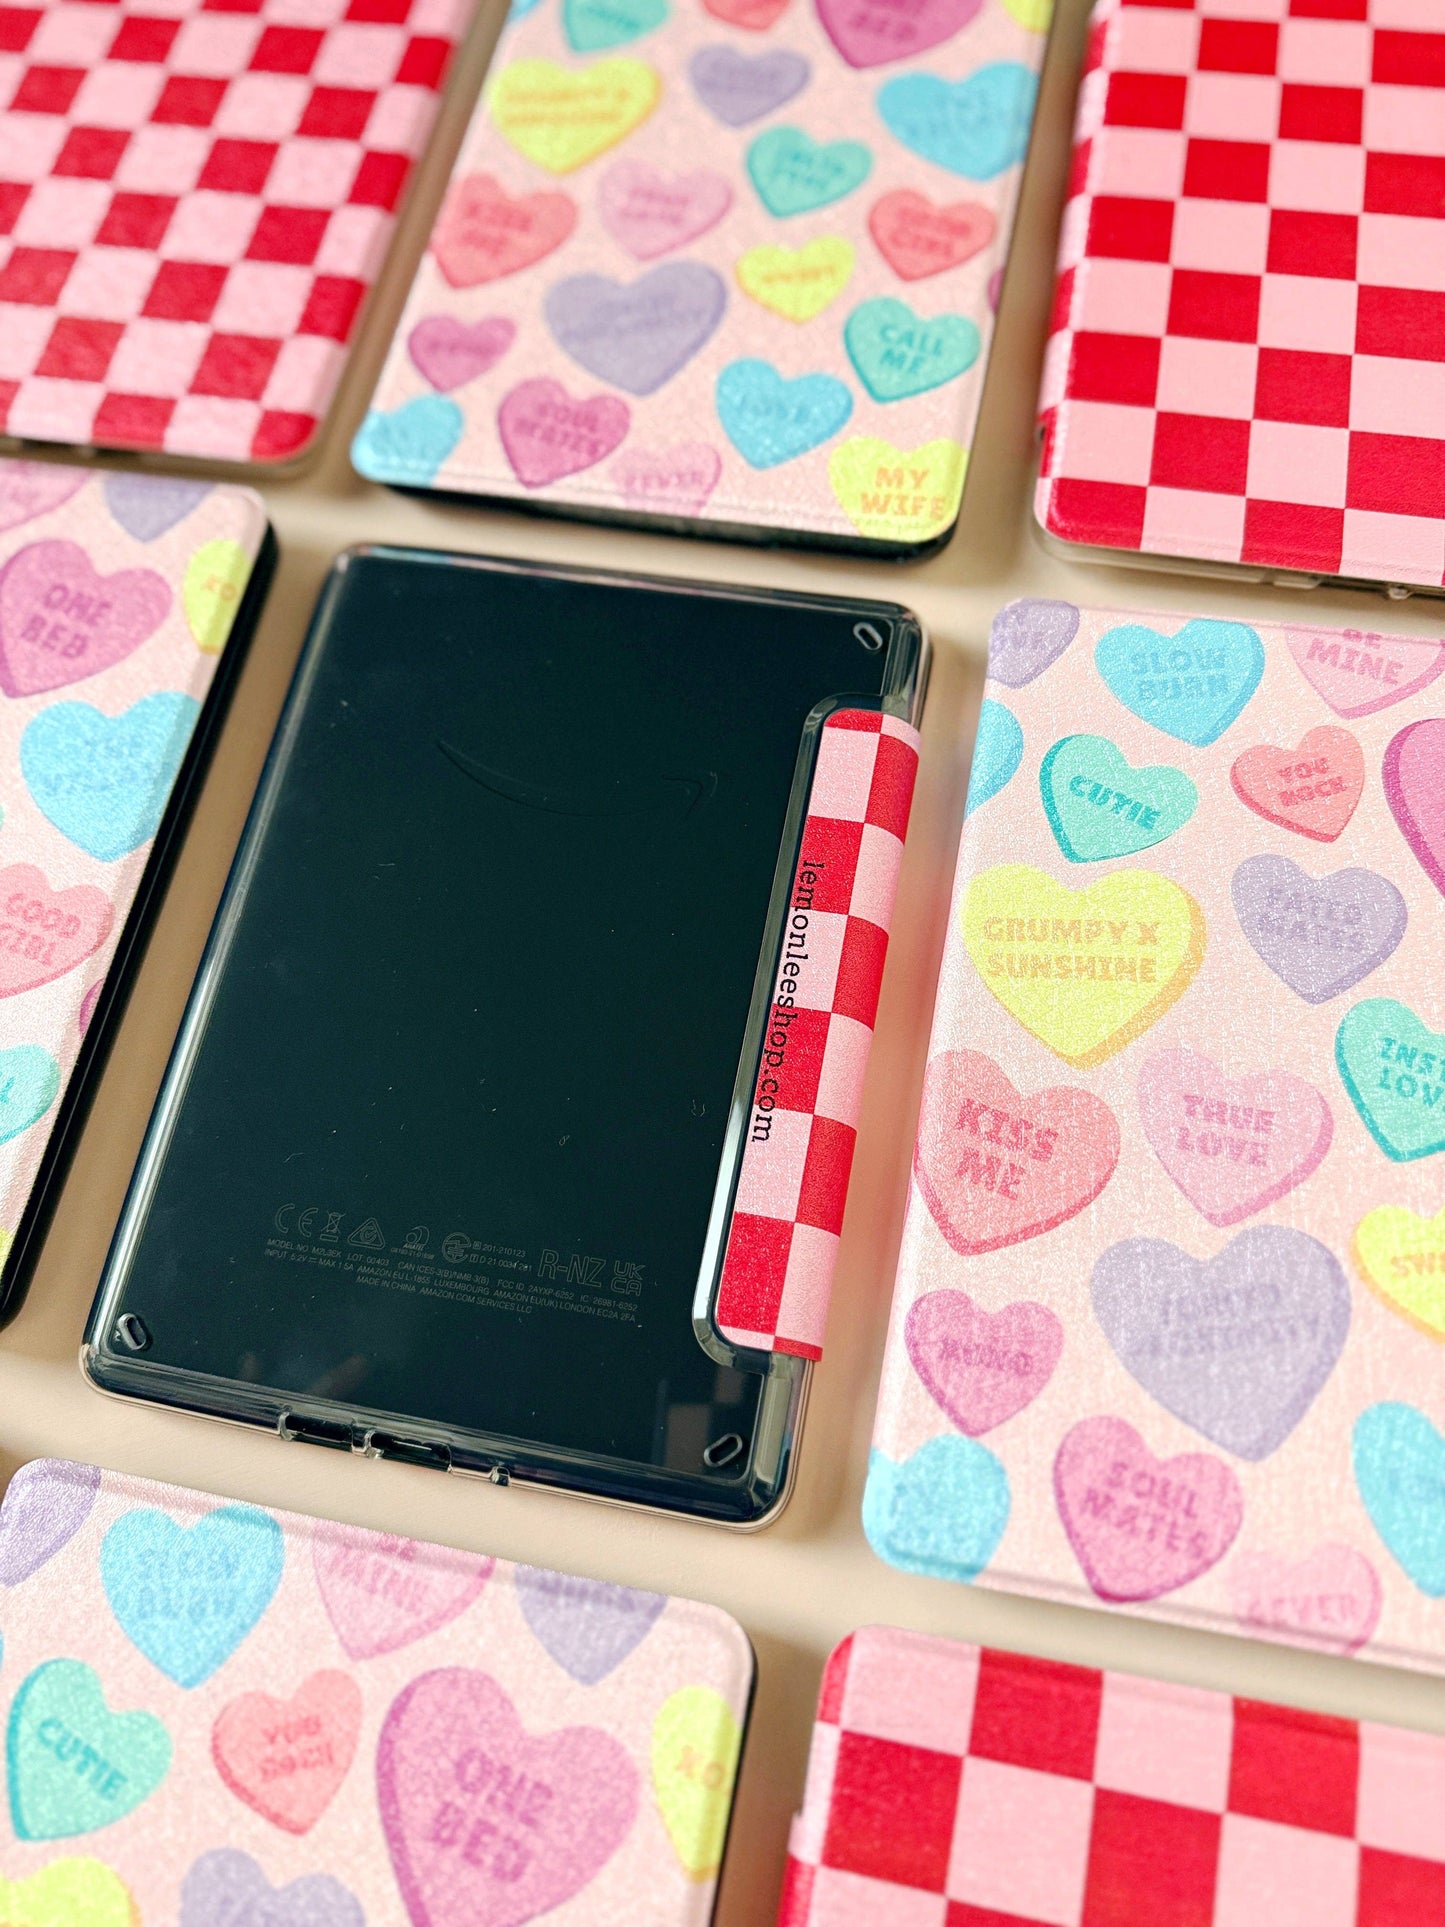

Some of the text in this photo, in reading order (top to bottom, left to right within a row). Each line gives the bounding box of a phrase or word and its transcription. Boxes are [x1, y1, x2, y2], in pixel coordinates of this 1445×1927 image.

[879, 322, 944, 357] CALL
[879, 348, 925, 375] ME
[875, 466, 931, 490] MY
[860, 490, 946, 523] WIFE
[43, 582, 113, 627] ONE
[20, 614, 88, 660] BED
[1306, 637, 1404, 686] MINE
[1068, 774, 1161, 832] CUTIE
[5, 893, 81, 939] GOOD
[983, 915, 1161, 947] GRUMPY X
[984, 952, 1158, 984] SUNSHINE
[751, 860, 825, 1143] lemonleeshop.com
[1375, 1067, 1445, 1110] LOV
[954, 1097, 1061, 1164] KISS
[1183, 1094, 1277, 1133] TRUE
[1177, 1127, 1270, 1168] LOVE
[955, 1145, 1026, 1201] ME
[266, 1238, 294, 1250] MODEL
[497, 1279, 515, 1290] FCC
[537, 1248, 607, 1288] R-NZ
[613, 1259, 647, 1281] UK
[355, 1274, 381, 1287] MADE
[476, 1295, 516, 1311] SERVICES
[516, 1304, 533, 1314] LLC
[356, 1264, 392, 1278] AMAZON
[493, 1289, 529, 1303] AMAZON
[559, 1300, 596, 1315] LONDON
[610, 1276, 643, 1298] CA
[1104, 1460, 1198, 1520] SOUL
[1080, 1486, 1207, 1559] MATES
[37, 1716, 128, 1801] CUTIE
[455, 1749, 553, 1829] ONE
[432, 1801, 531, 1883] BED
